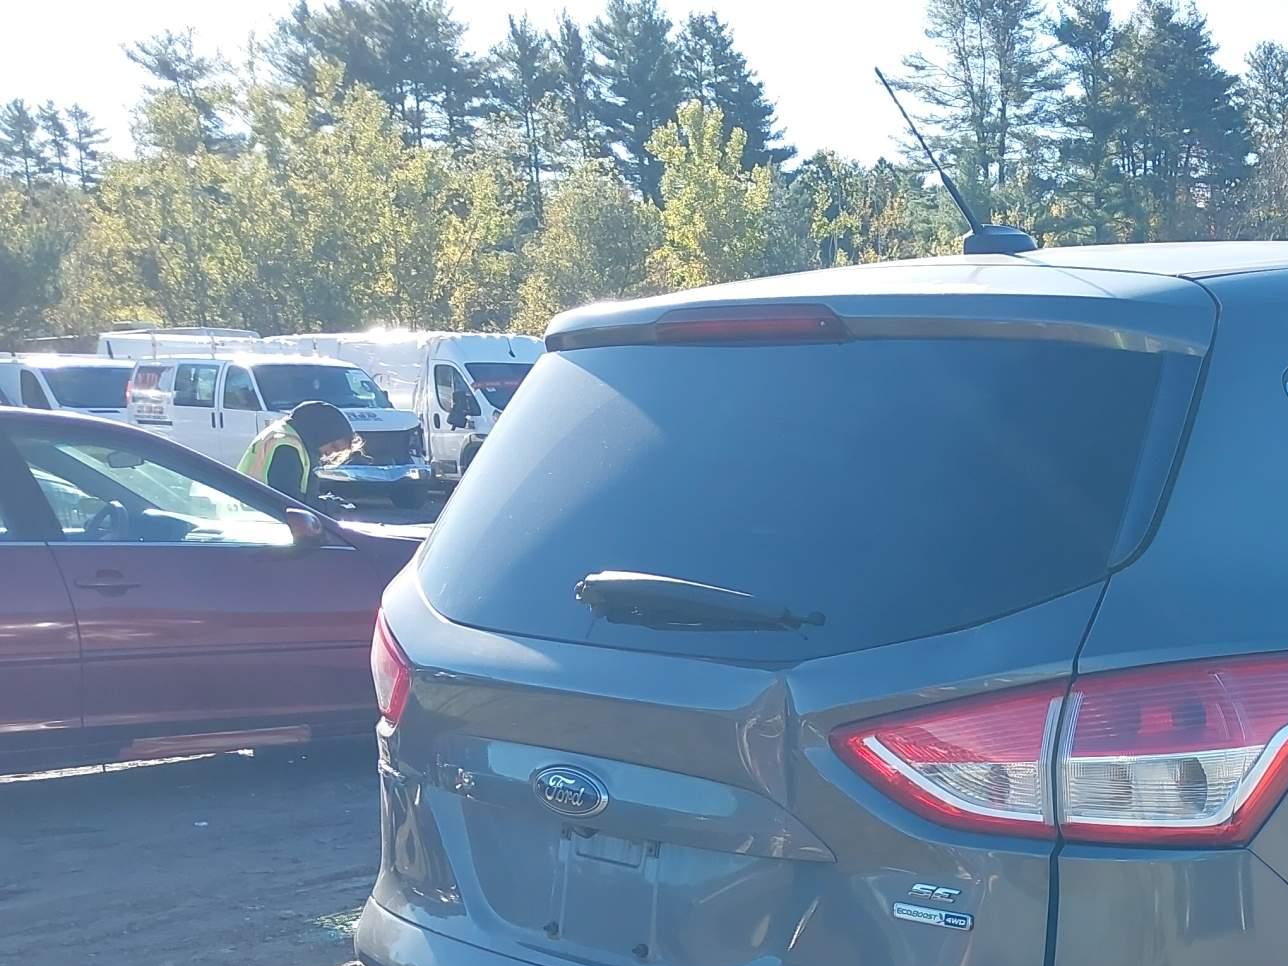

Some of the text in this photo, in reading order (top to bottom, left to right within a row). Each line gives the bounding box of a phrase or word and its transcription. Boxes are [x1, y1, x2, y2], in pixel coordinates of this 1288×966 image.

[545, 774, 585, 807] Ford
[908, 883, 961, 903] SE
[945, 917, 967, 926] 4WD
